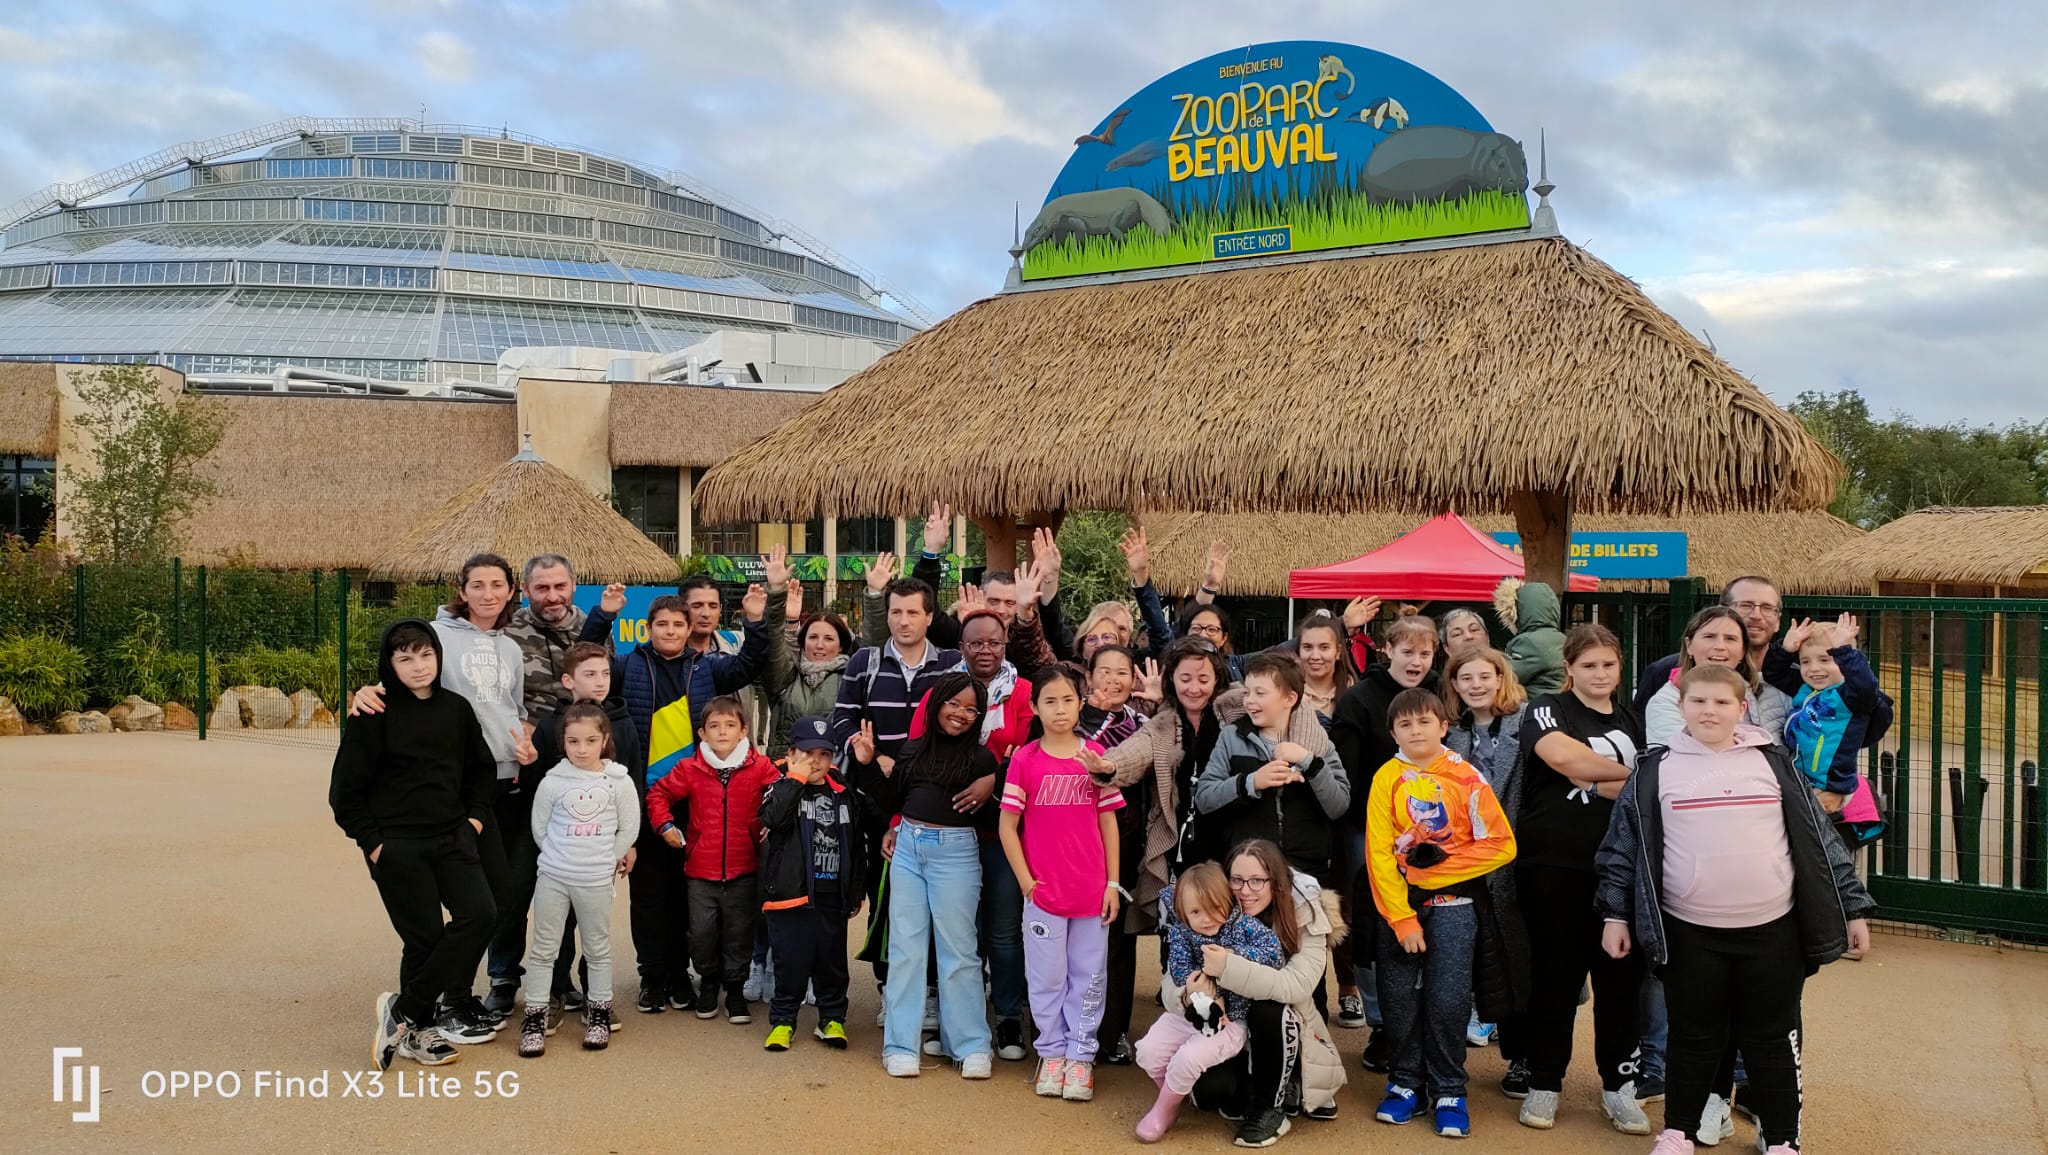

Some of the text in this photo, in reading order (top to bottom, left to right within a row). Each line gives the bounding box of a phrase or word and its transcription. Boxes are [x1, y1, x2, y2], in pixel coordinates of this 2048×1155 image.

[1219, 56, 1284, 79] BIENVENUE AU
[1168, 76, 1339, 142] ZOOPARC
[1248, 114, 1264, 129] de
[1167, 123, 1338, 182] BEAUVAL
[1218, 233, 1286, 253] ENTRÉE NORD
[1570, 543, 1659, 557] DE BILLETS
[619, 618, 650, 643] NO
[1034, 774, 1094, 806] NIKE
[566, 824, 602, 837] LOVE
